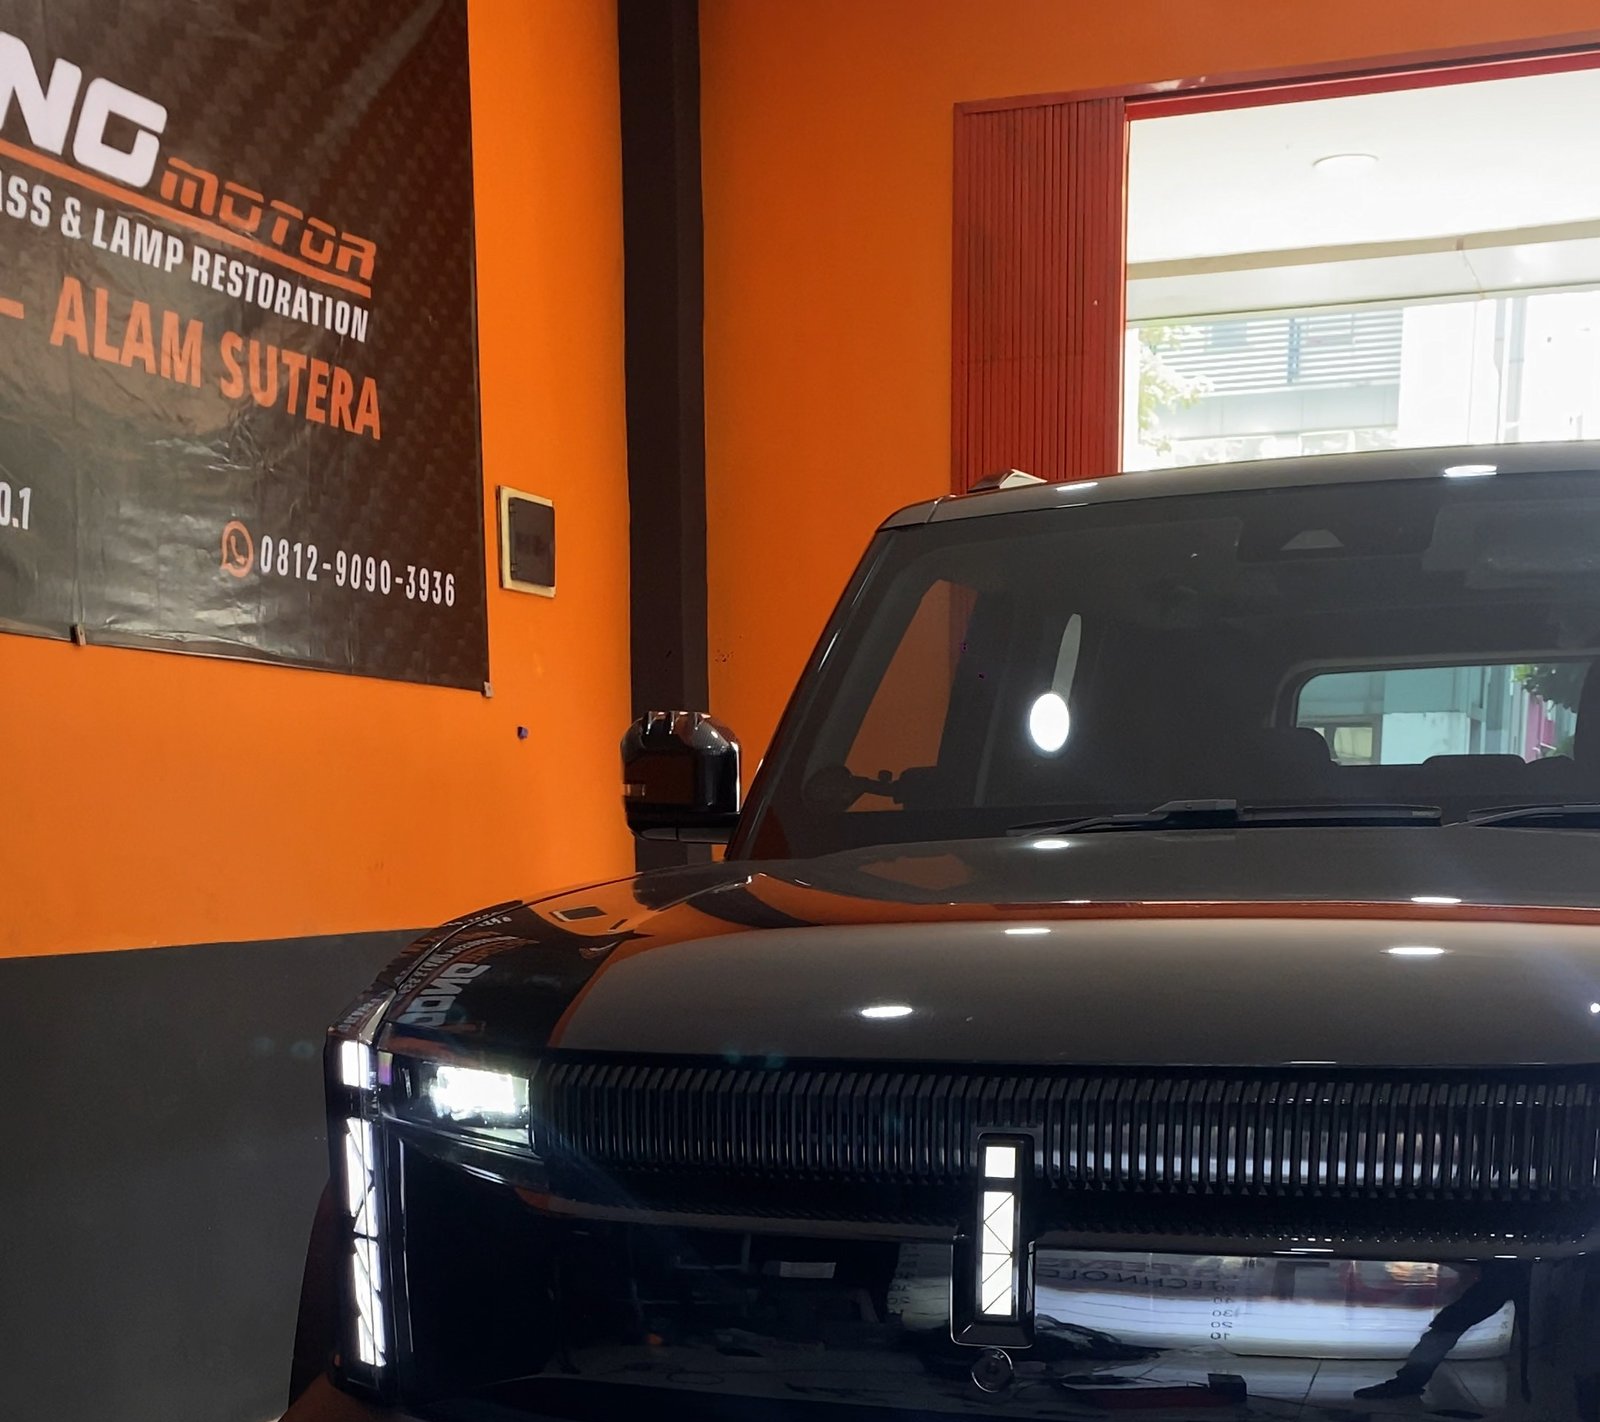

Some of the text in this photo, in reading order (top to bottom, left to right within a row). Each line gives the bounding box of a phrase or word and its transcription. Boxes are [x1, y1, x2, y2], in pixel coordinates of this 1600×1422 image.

[0, 168, 370, 344] SS & LAMP RESTORATION
[160, 156, 377, 281] MOTOR
[50, 275, 204, 388] ALAM
[220, 330, 382, 441] SUTERA
[260, 535, 456, 607] 0812-9090-3936
